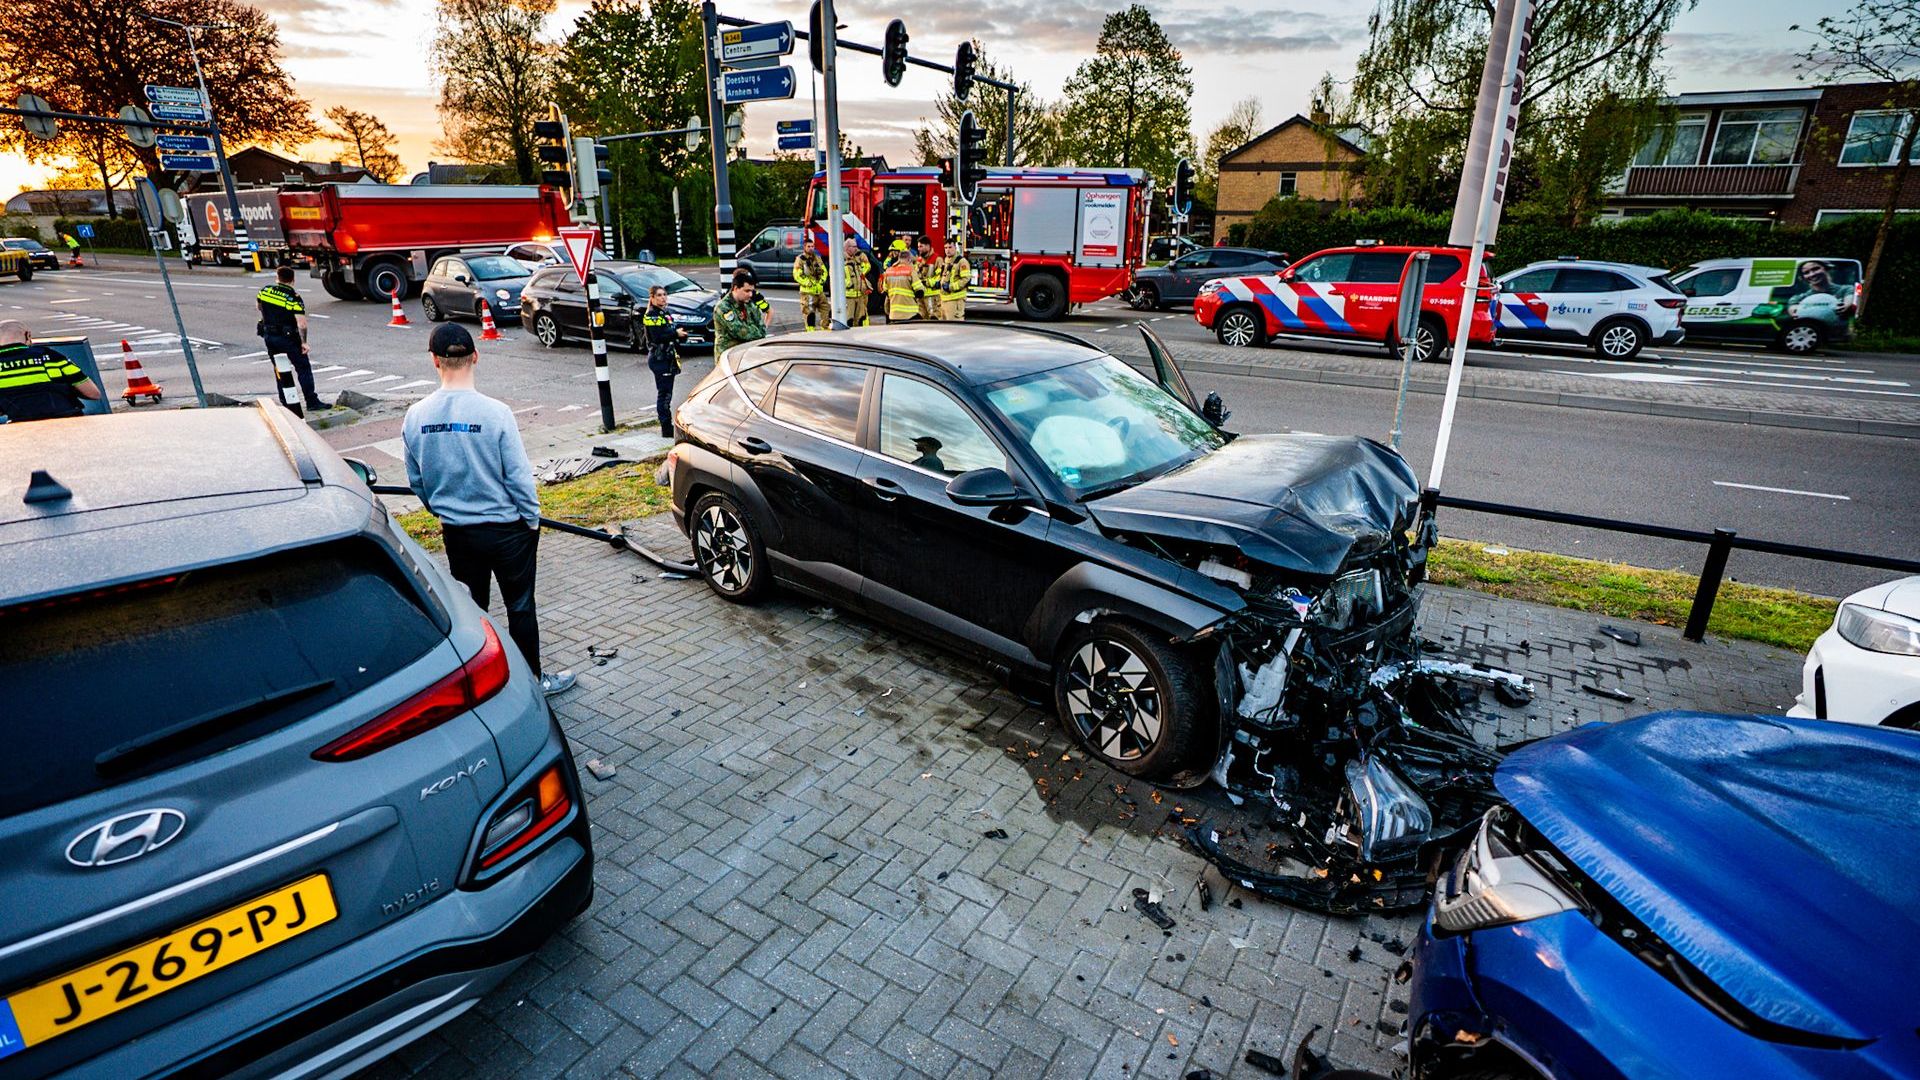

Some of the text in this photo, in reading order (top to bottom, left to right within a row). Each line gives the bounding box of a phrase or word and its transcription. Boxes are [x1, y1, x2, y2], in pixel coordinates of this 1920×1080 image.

[725, 45, 752, 55] Centrum
[726, 75, 756, 85] Doesburg
[727, 89, 752, 97] Arnhem
[931, 195, 939, 228] 07-5141
[420, 758, 489, 801] KONA
[382, 878, 441, 916] hybrid
[54, 891, 307, 1026] J-269-PJ
